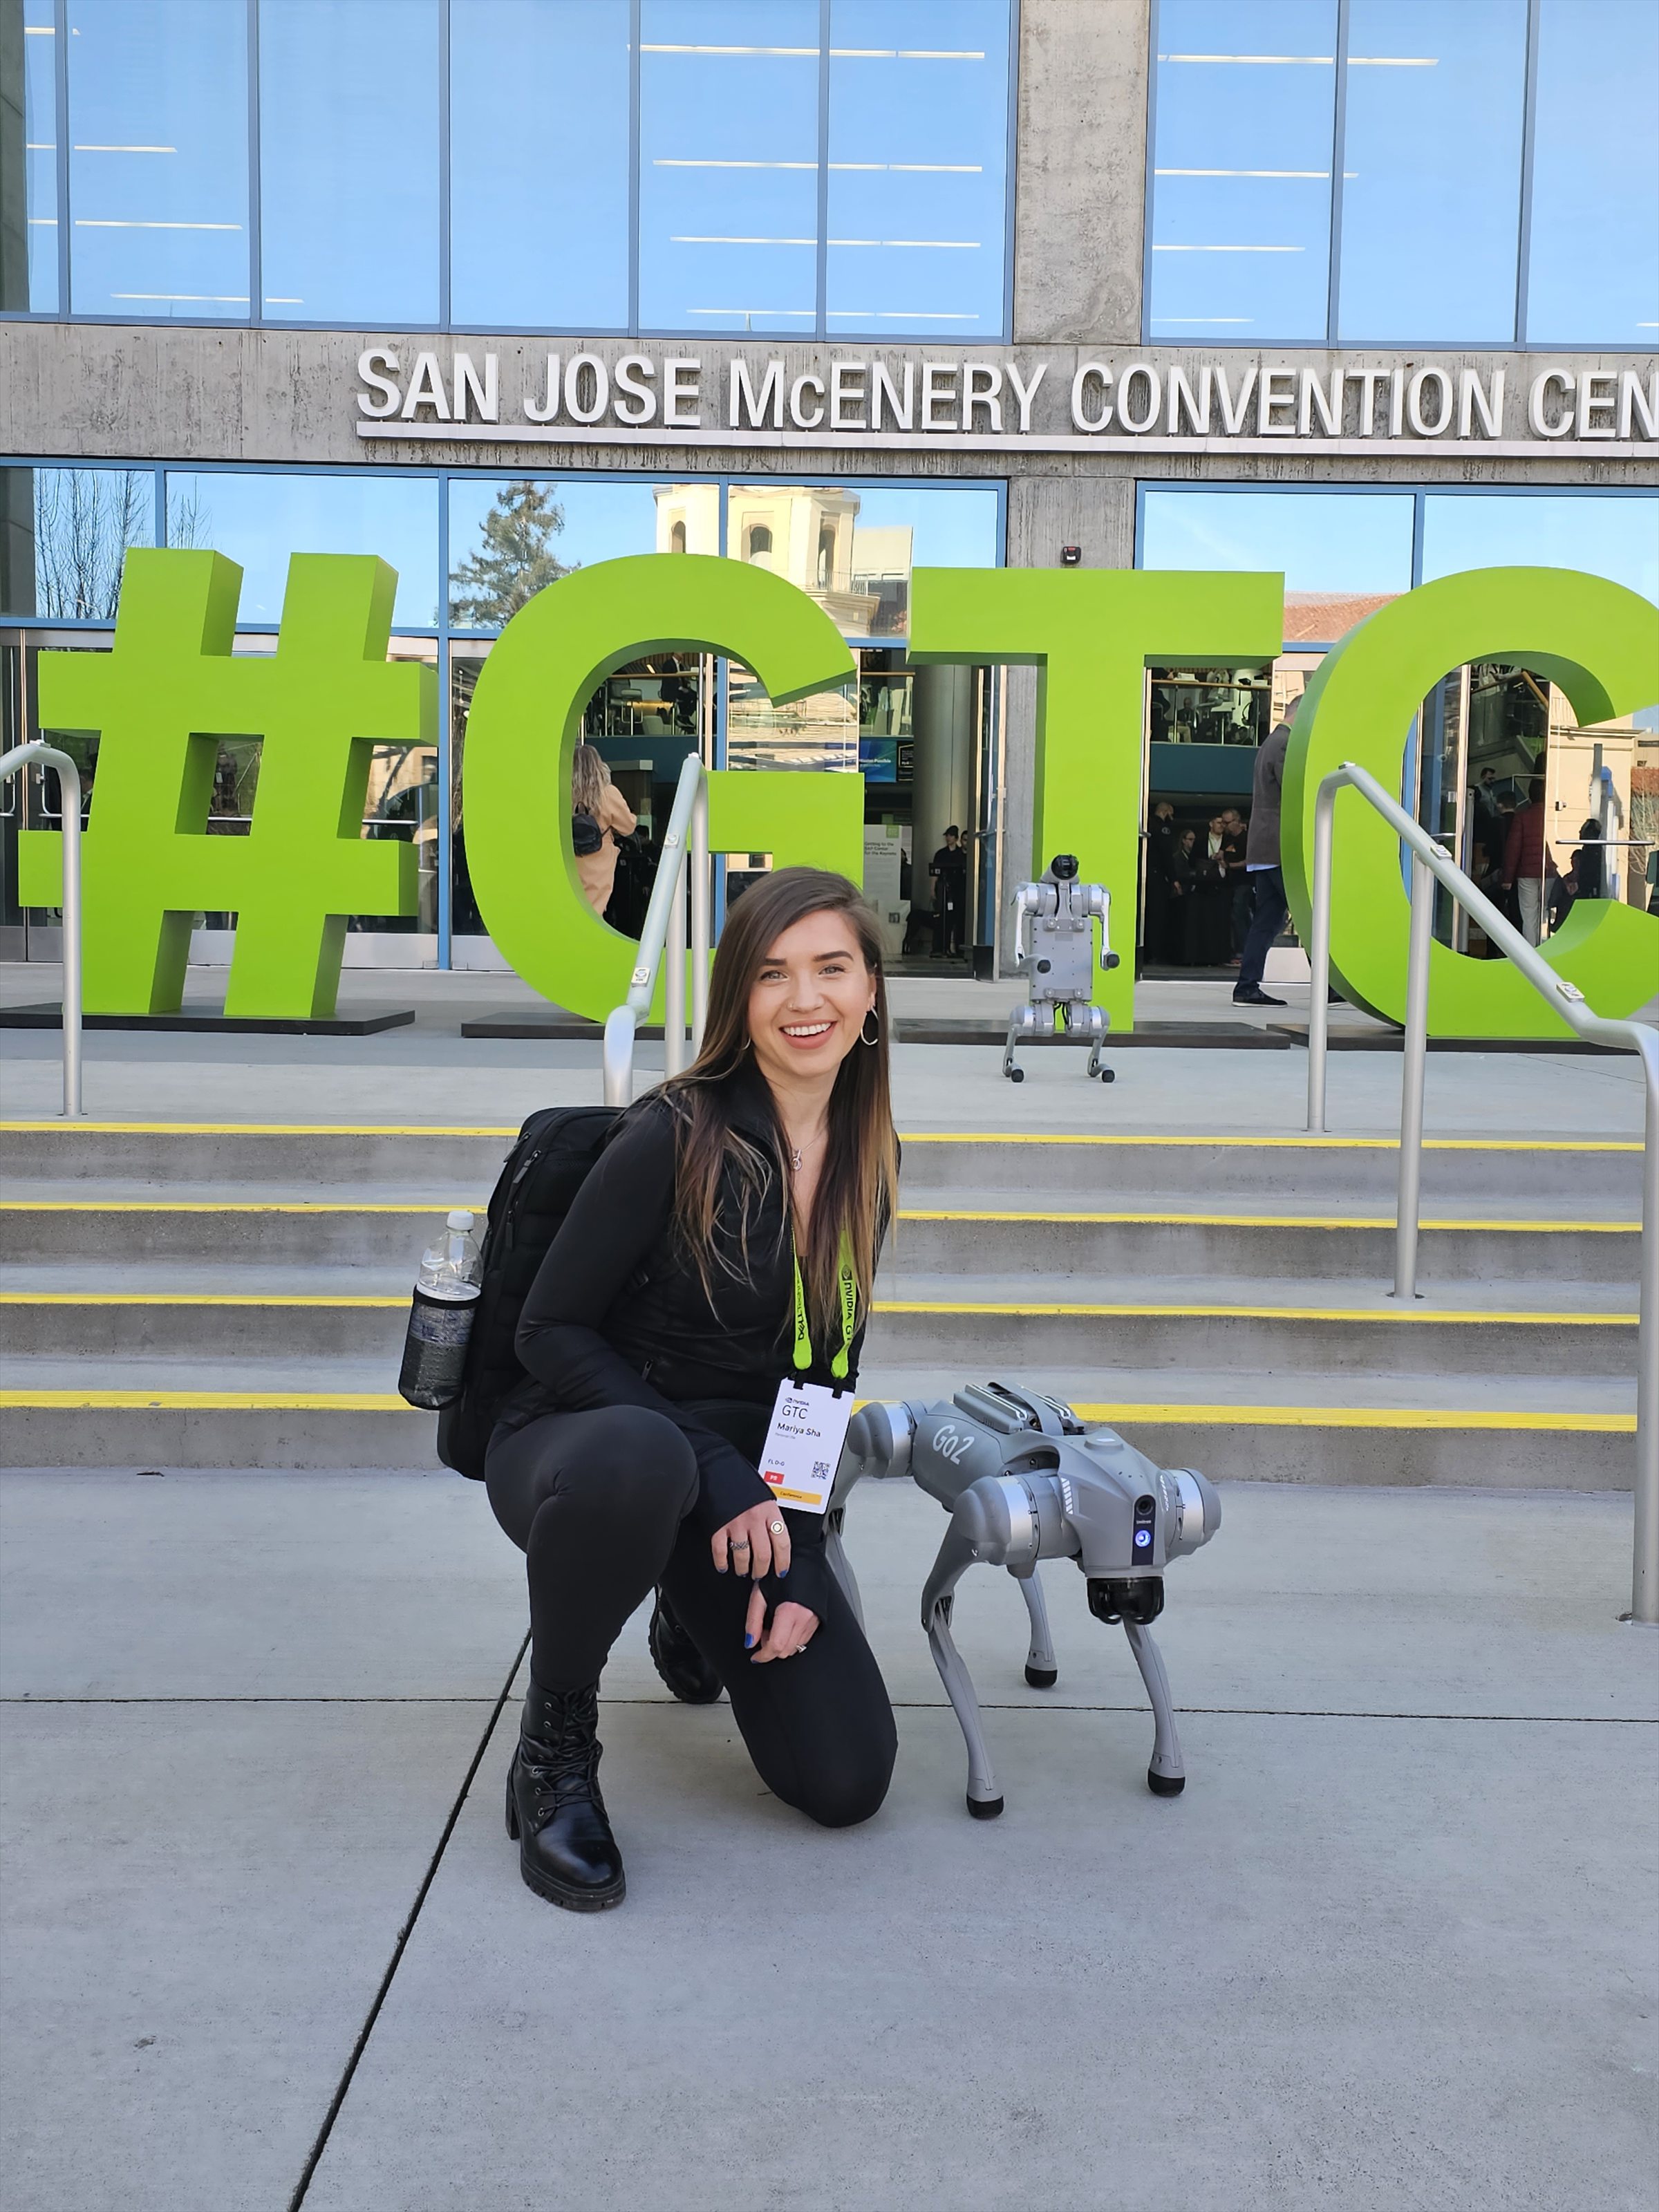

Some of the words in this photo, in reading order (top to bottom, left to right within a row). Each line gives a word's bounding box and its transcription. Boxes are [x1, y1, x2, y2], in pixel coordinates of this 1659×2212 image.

[356, 347, 498, 424] SAN
[523, 351, 702, 429] JOSE
[1070, 362, 1506, 440] CONVENTION
[1528, 368, 1659, 440] CEN
[782, 1405, 808, 1420] GTC
[777, 1423, 805, 1434] Mariya
[805, 1427, 821, 1438] Sha
[932, 1424, 975, 1465] Go2
